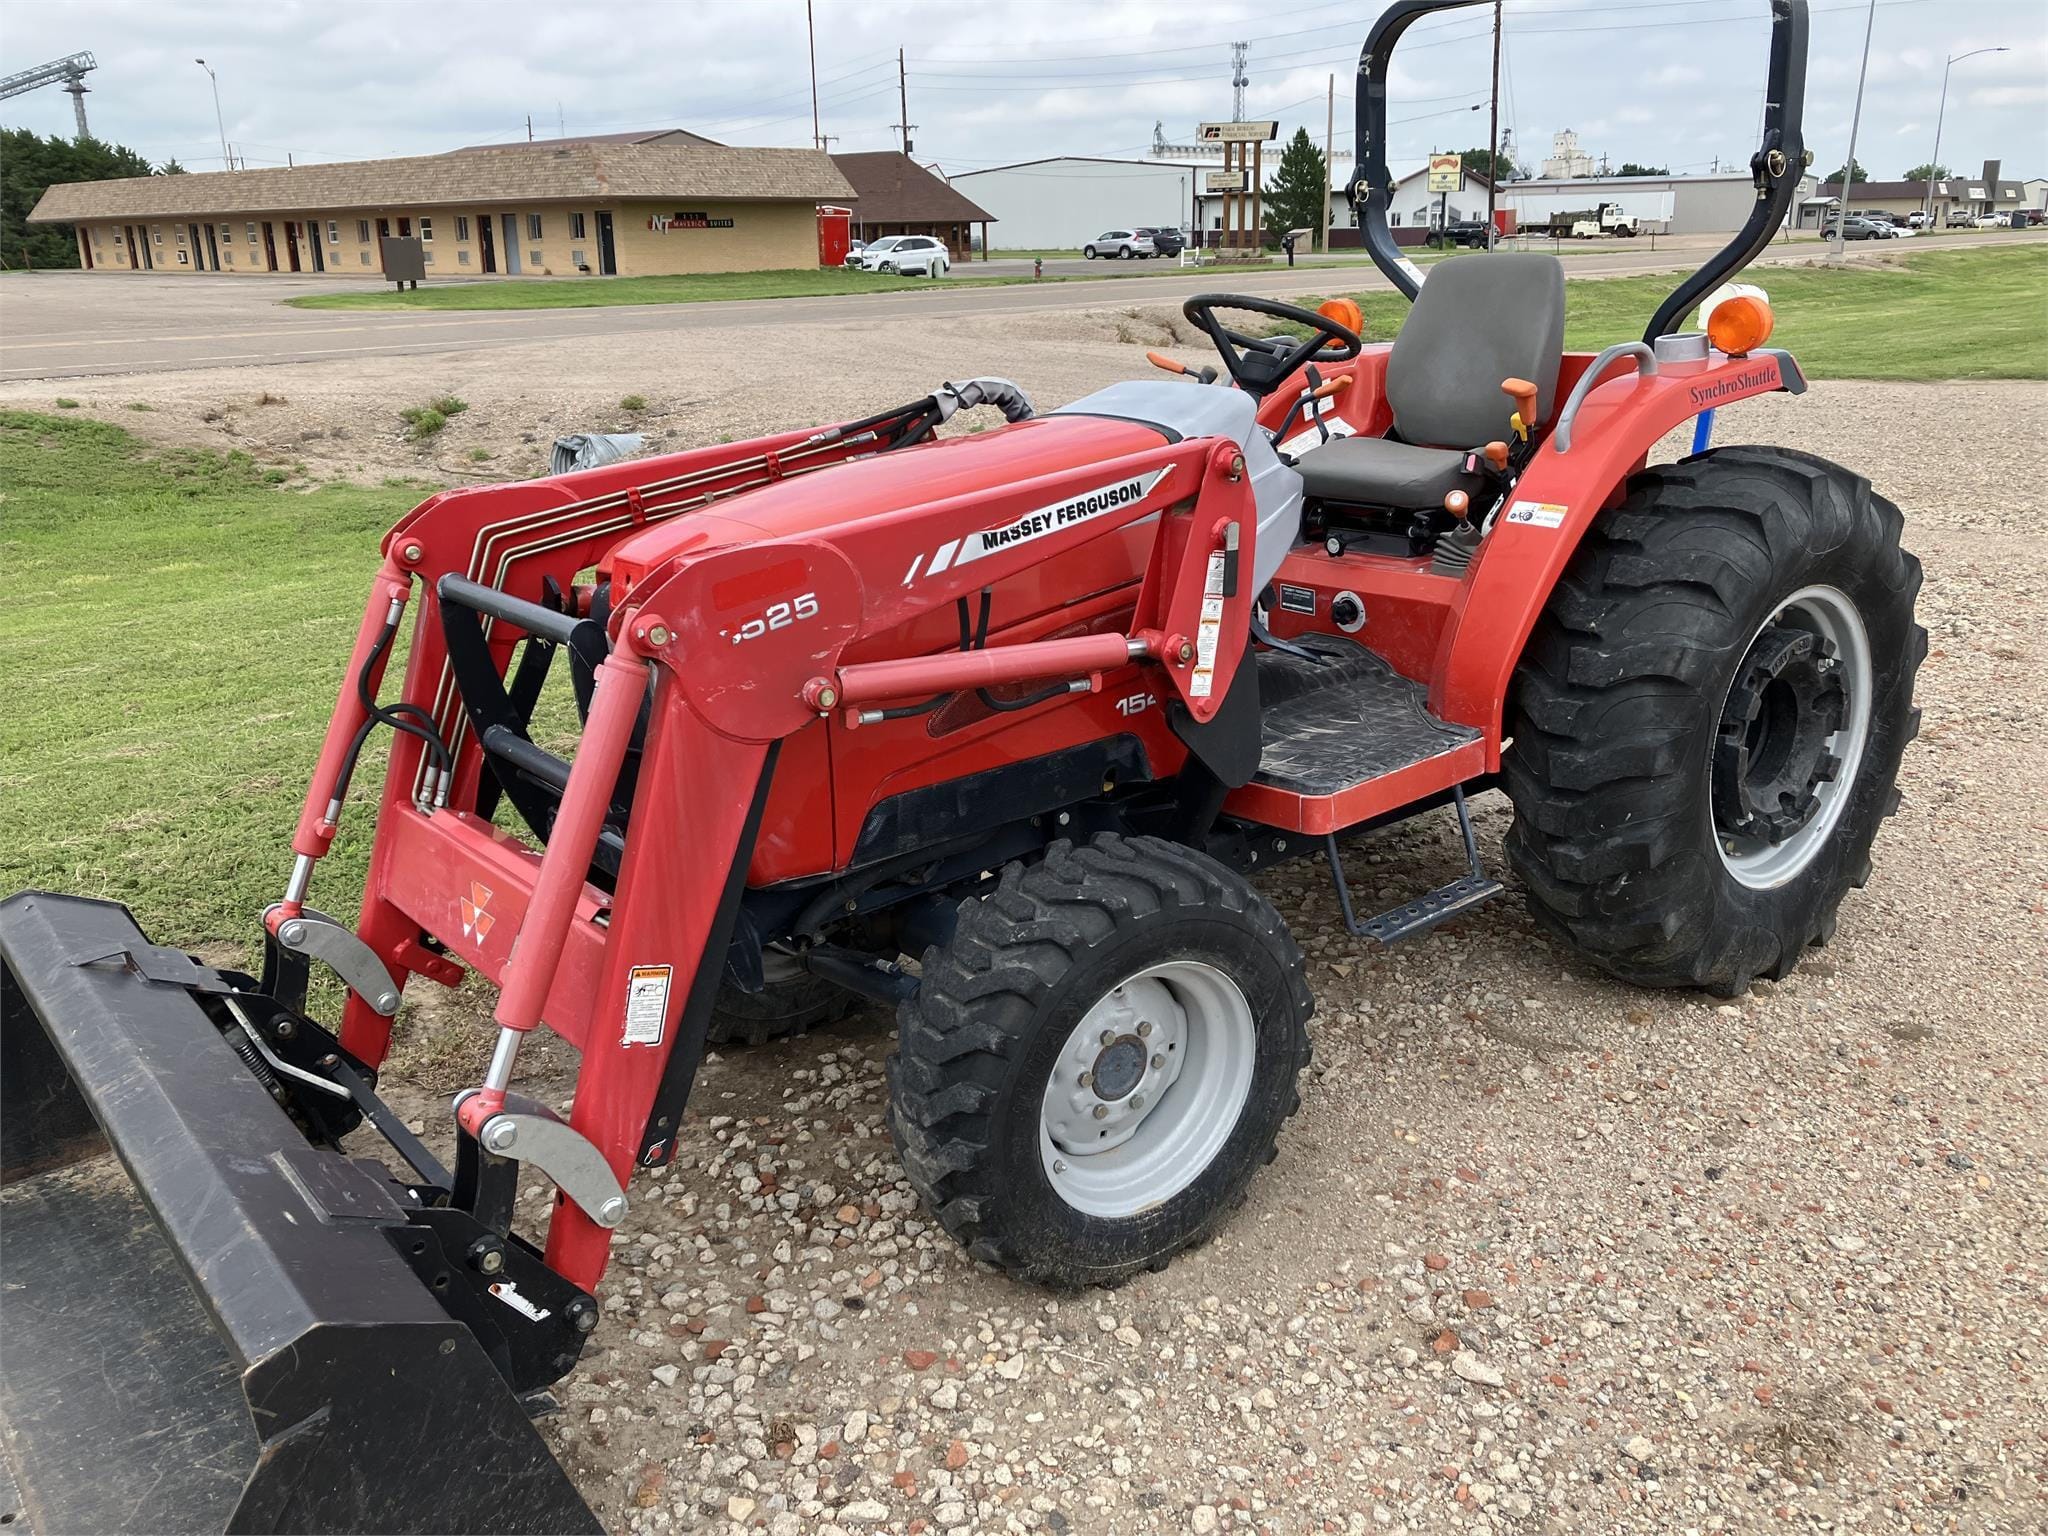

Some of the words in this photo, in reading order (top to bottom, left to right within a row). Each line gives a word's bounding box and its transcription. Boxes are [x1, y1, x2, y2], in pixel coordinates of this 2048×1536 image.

[673, 219, 707, 228] MAVERICK
[709, 219, 733, 227] SUITES
[1690, 368, 1776, 406] SynchroShuttle
[982, 511, 1053, 551] MASSEY
[1056, 481, 1143, 525] FERGUSON
